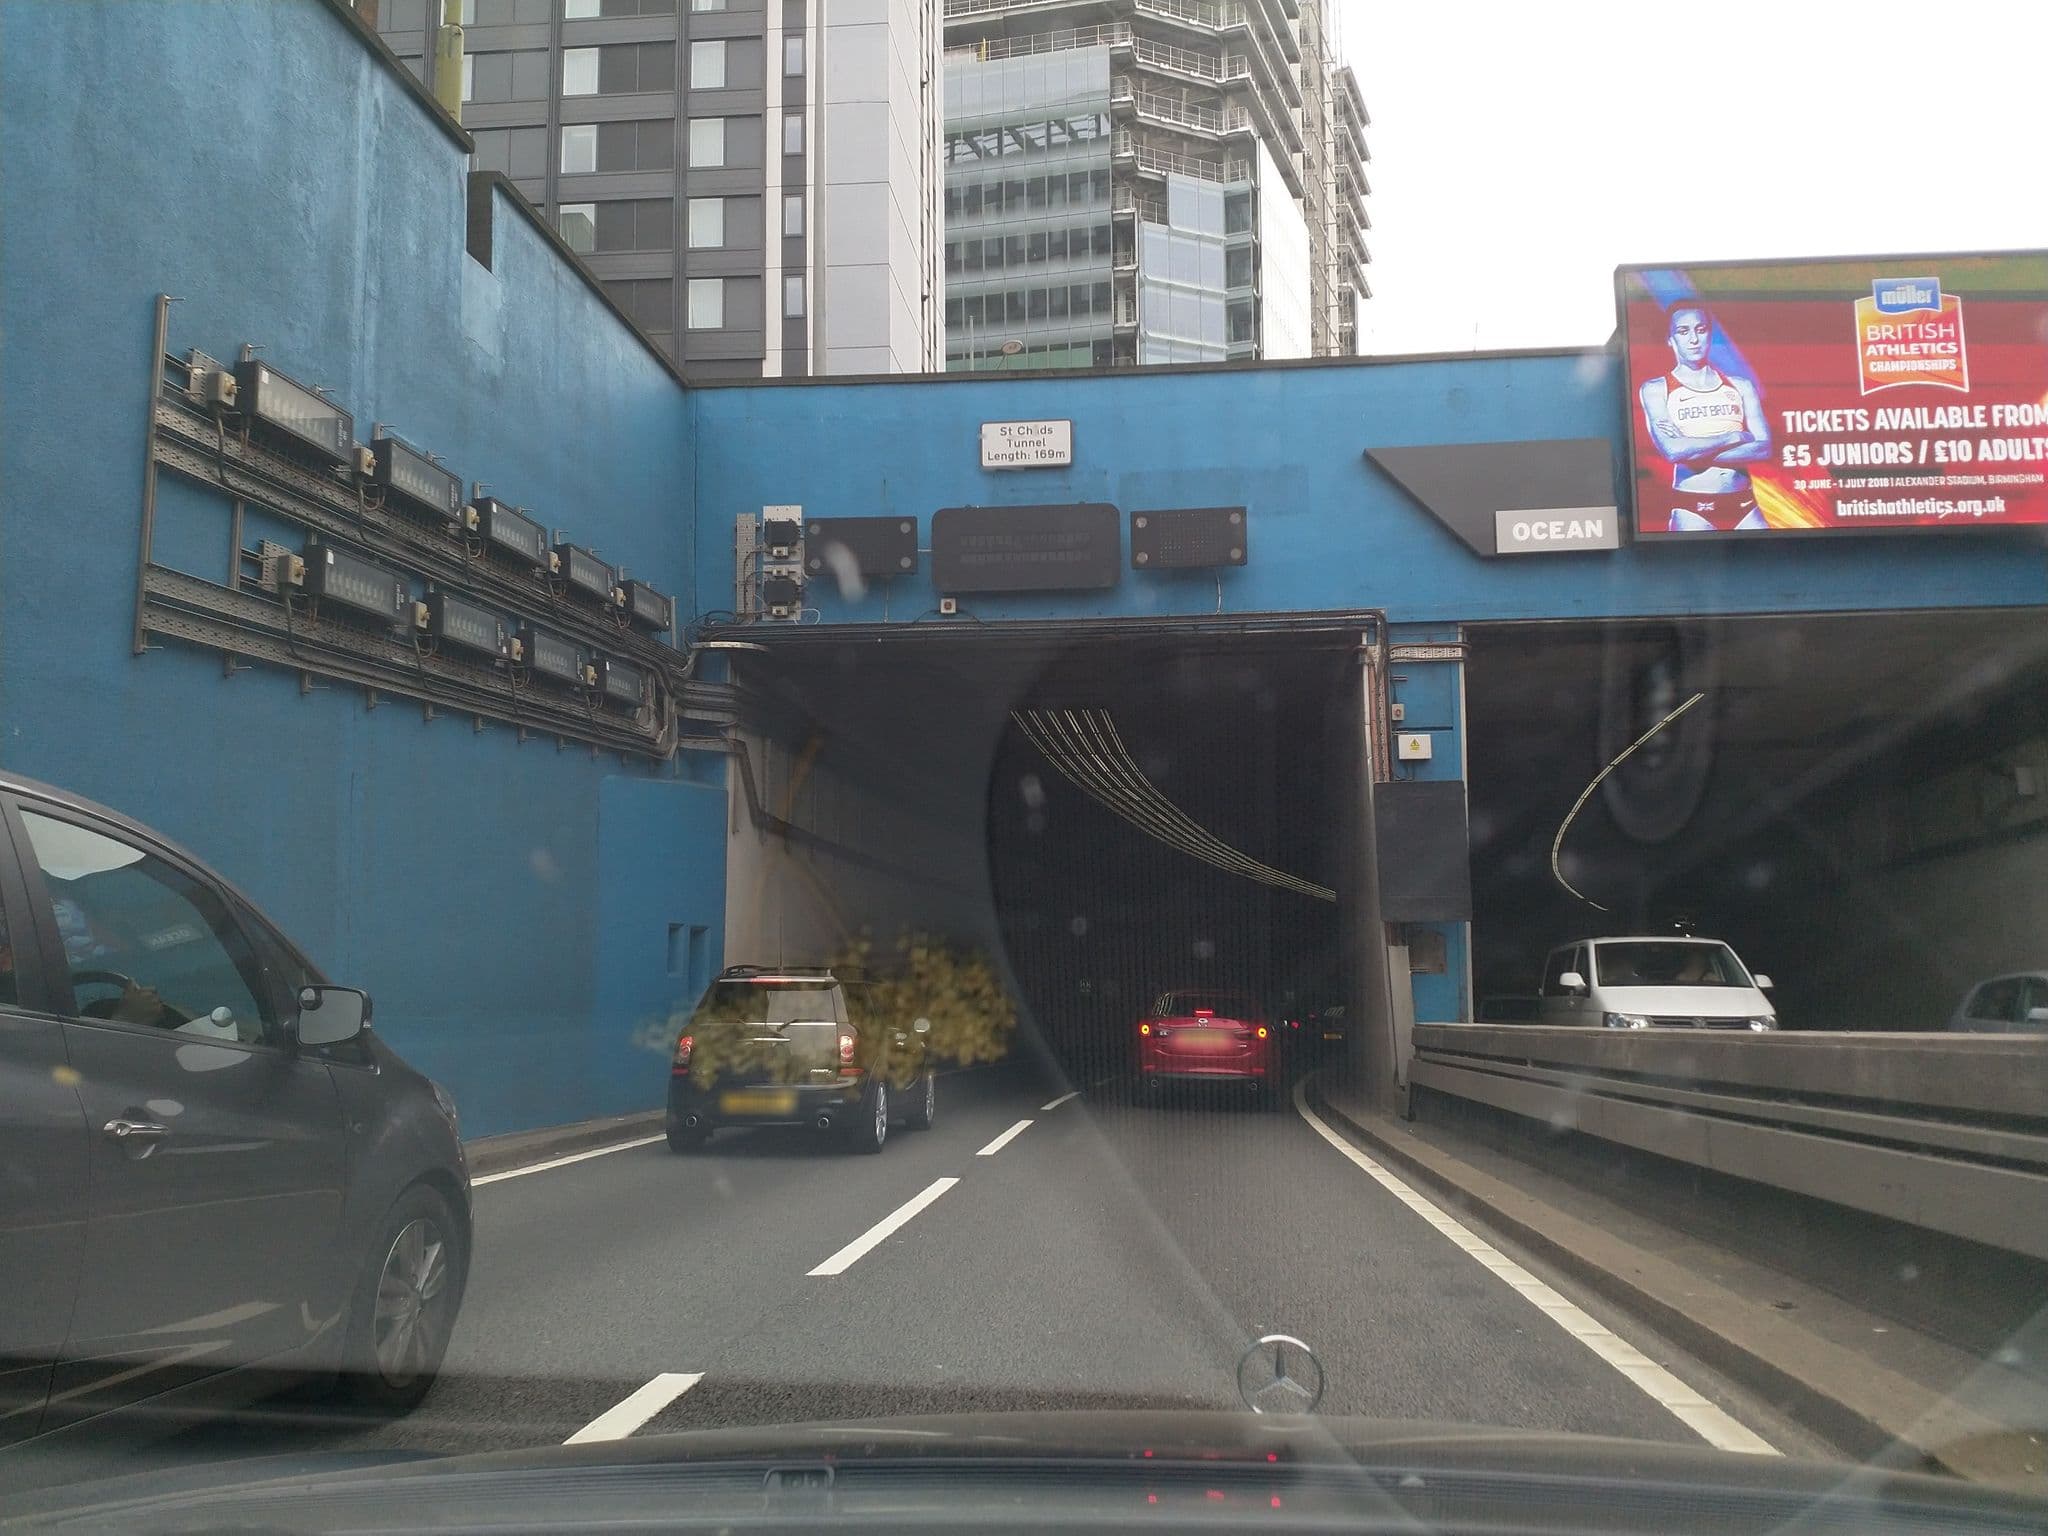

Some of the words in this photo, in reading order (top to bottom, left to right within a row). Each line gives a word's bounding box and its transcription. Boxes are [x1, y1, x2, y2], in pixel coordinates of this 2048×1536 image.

[1866, 323, 1955, 341] BRITISH
[1866, 342, 1959, 357] ATHLETICS
[1869, 359, 1957, 373] CHAMPIONSHIPS
[1677, 405, 1708, 421] GREAT
[1782, 408, 1870, 433] TICKETS
[1874, 405, 1988, 430] AVAILABLE
[1992, 403, 2048, 427] FROM
[1000, 427, 1012, 436] St
[1007, 438, 1046, 448] Tunnel
[987, 450, 1030, 461] Length:
[1035, 449, 1065, 459] 169m
[1782, 444, 1812, 467] £5
[1816, 441, 1914, 467] JUNIORS
[1934, 439, 1973, 463] £10
[1977, 437, 2048, 461] ADULT
[1807, 479, 1832, 489] JUNE
[1844, 478, 1867, 488] JULY
[1895, 475, 1946, 487] ALEXANDER
[1837, 496, 2006, 516] britishathletics.org.uk
[1512, 519, 1604, 541] OCEAN
